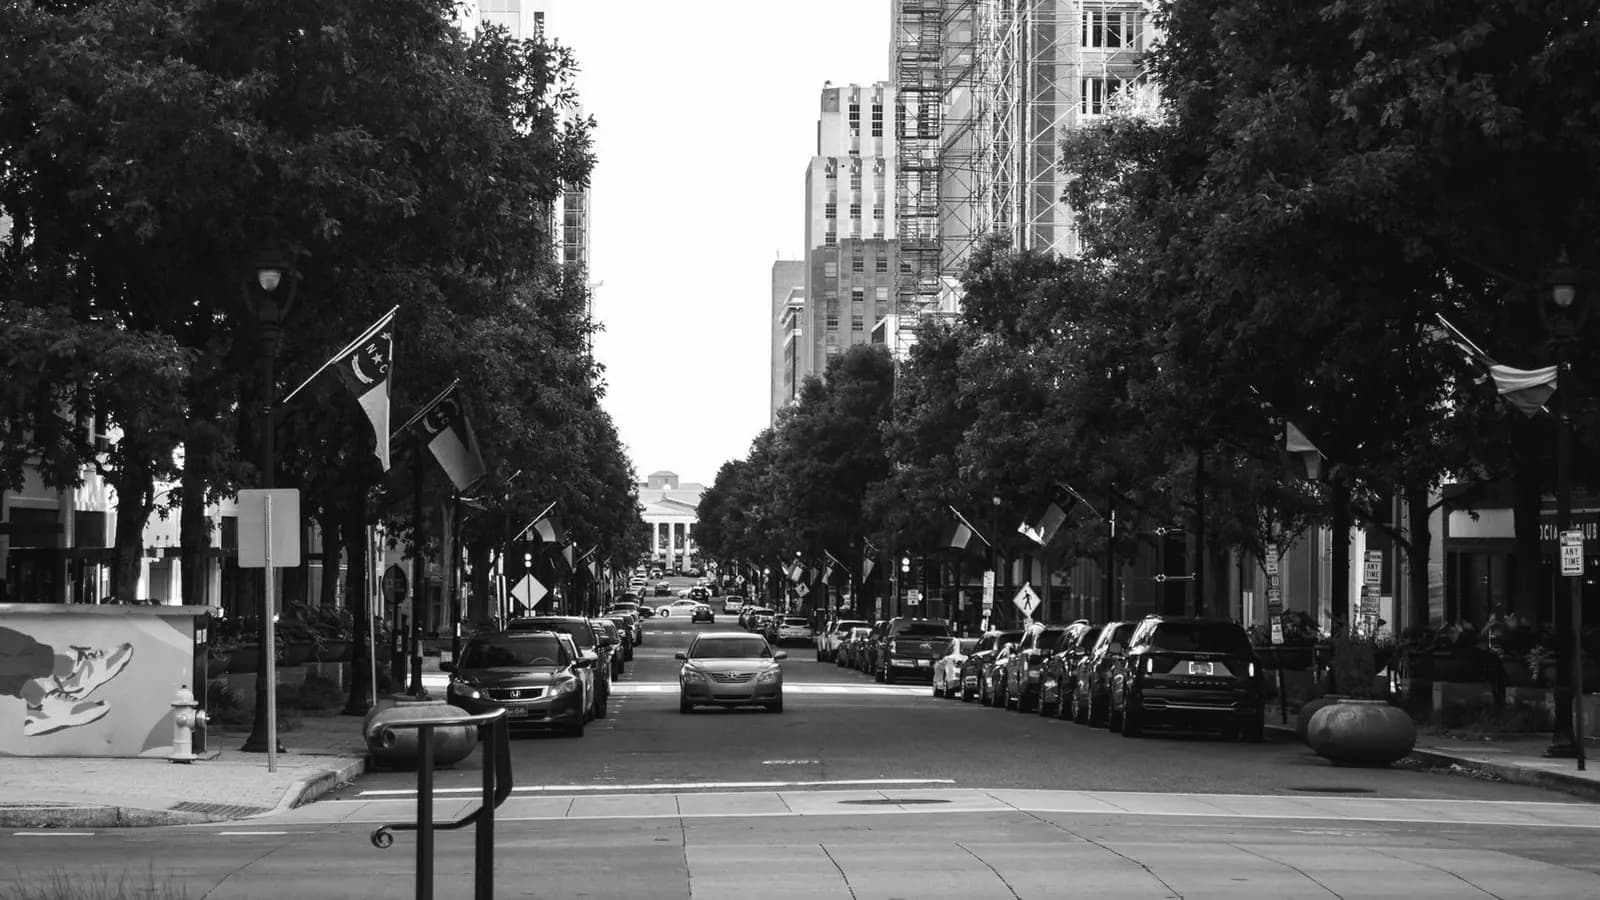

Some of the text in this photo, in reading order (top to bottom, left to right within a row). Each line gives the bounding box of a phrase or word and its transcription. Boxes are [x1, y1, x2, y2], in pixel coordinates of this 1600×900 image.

[365, 343, 389, 373] N C
[1565, 548, 1579, 556] ANY
[1564, 557, 1580, 566] TIME
